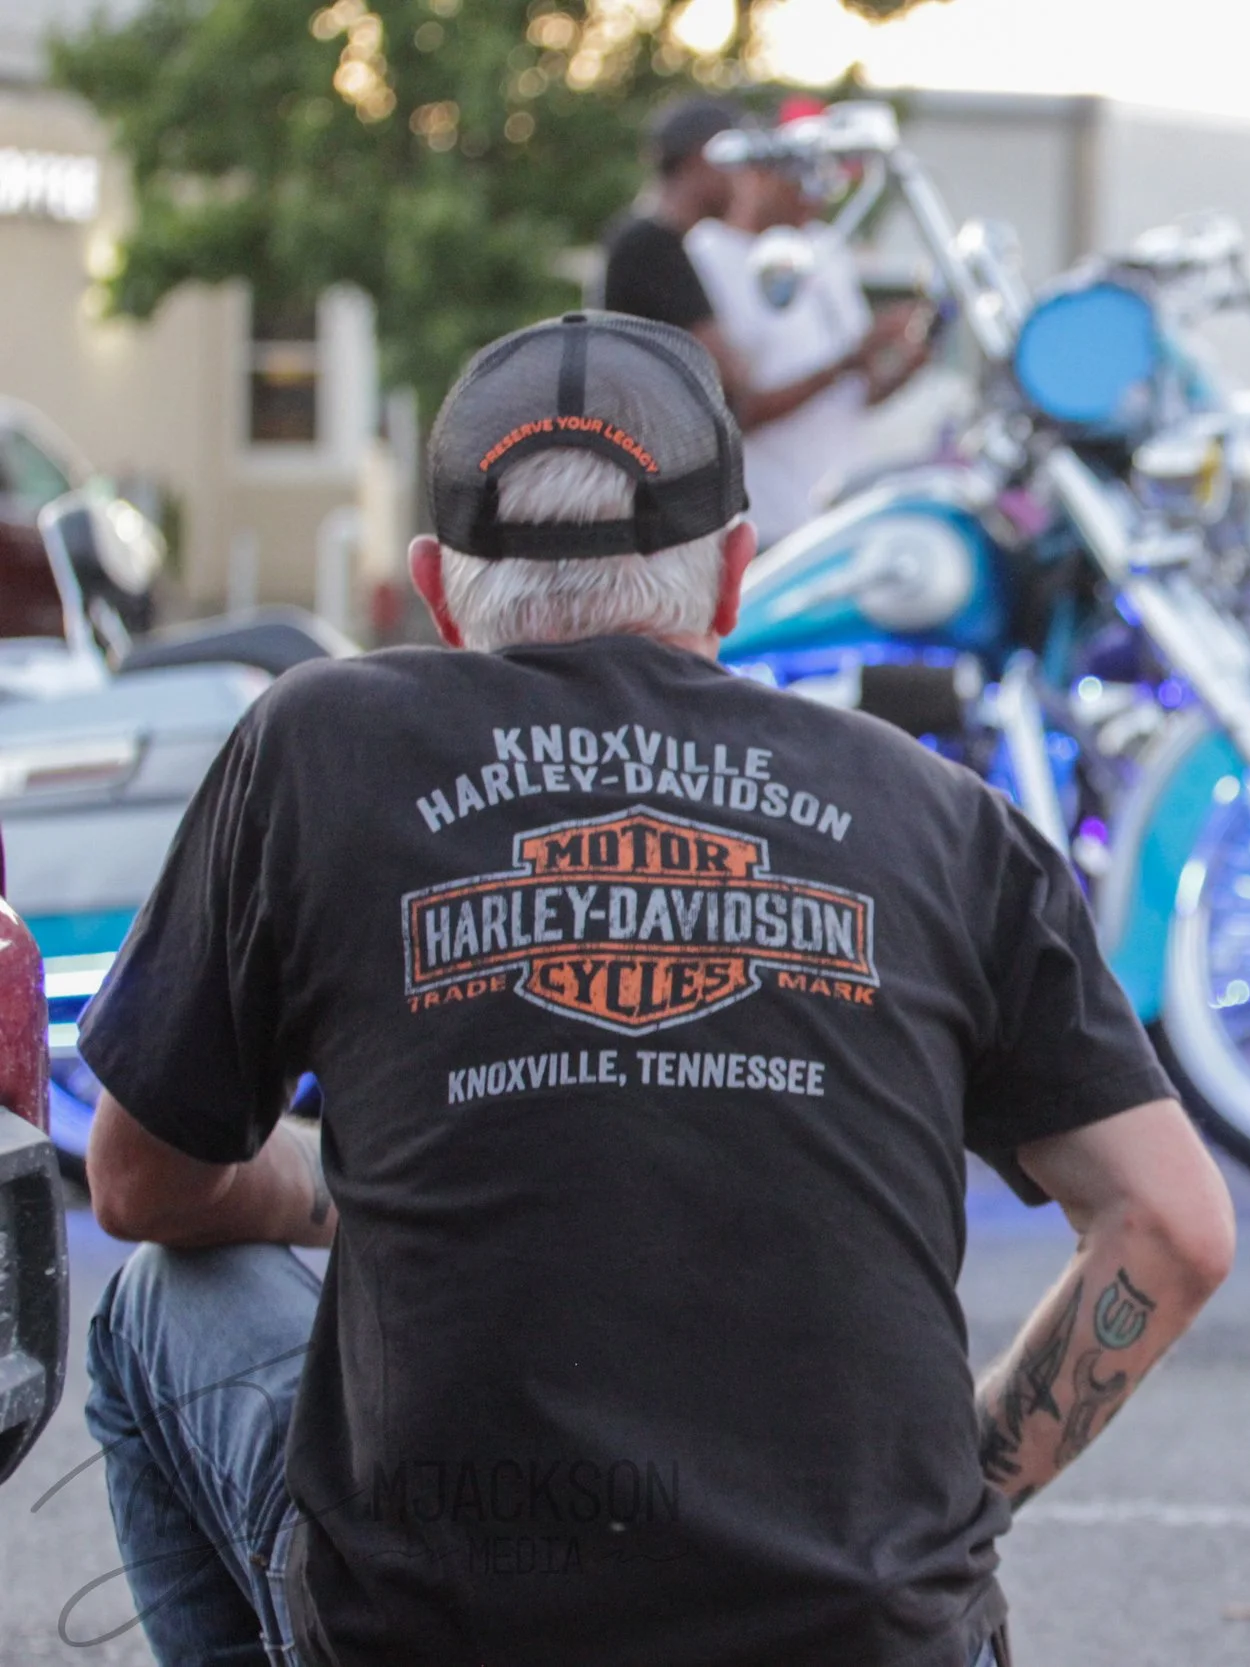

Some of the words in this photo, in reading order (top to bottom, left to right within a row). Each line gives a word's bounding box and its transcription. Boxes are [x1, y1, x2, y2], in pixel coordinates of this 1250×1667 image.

[480, 418, 553, 472] PRESERVE
[557, 416, 603, 433] YOUR
[604, 424, 659, 473] LEGACY
[493, 724, 773, 780] KNOXVILLE
[416, 762, 852, 842] HARLEY-DAVIDSON
[544, 823, 730, 872] MOTOR
[425, 886, 855, 967] HARLEY-DAVIDSON
[406, 978, 507, 1014] TRADE
[539, 961, 746, 1018] CYCLES
[778, 972, 874, 1006] MARK
[448, 1050, 628, 1104] KNOXVILLE,
[636, 1051, 825, 1096] TENNESSEE
